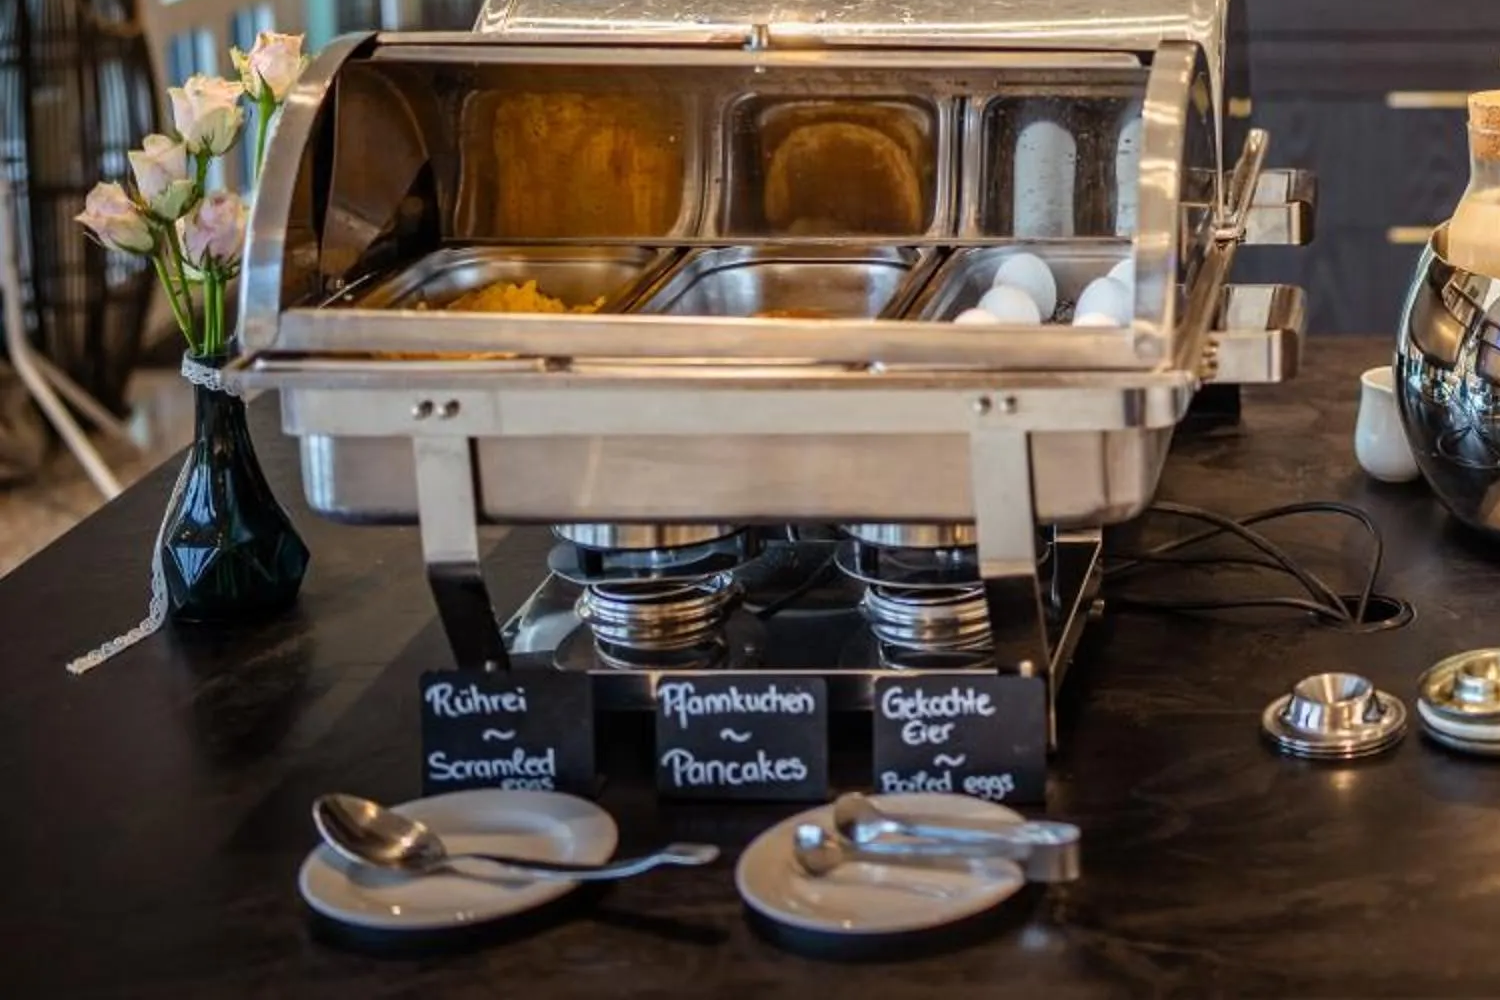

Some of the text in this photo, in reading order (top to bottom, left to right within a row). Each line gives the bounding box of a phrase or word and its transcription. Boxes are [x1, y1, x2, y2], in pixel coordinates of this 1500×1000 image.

[425, 682, 527, 717] Rührei
[657, 682, 815, 729] Pfannkuchen
[881, 686, 997, 719] Gekochte
[901, 718, 956, 745] Eier
[660, 748, 808, 787] Pancakes
[963, 773, 1015, 800] eggs
